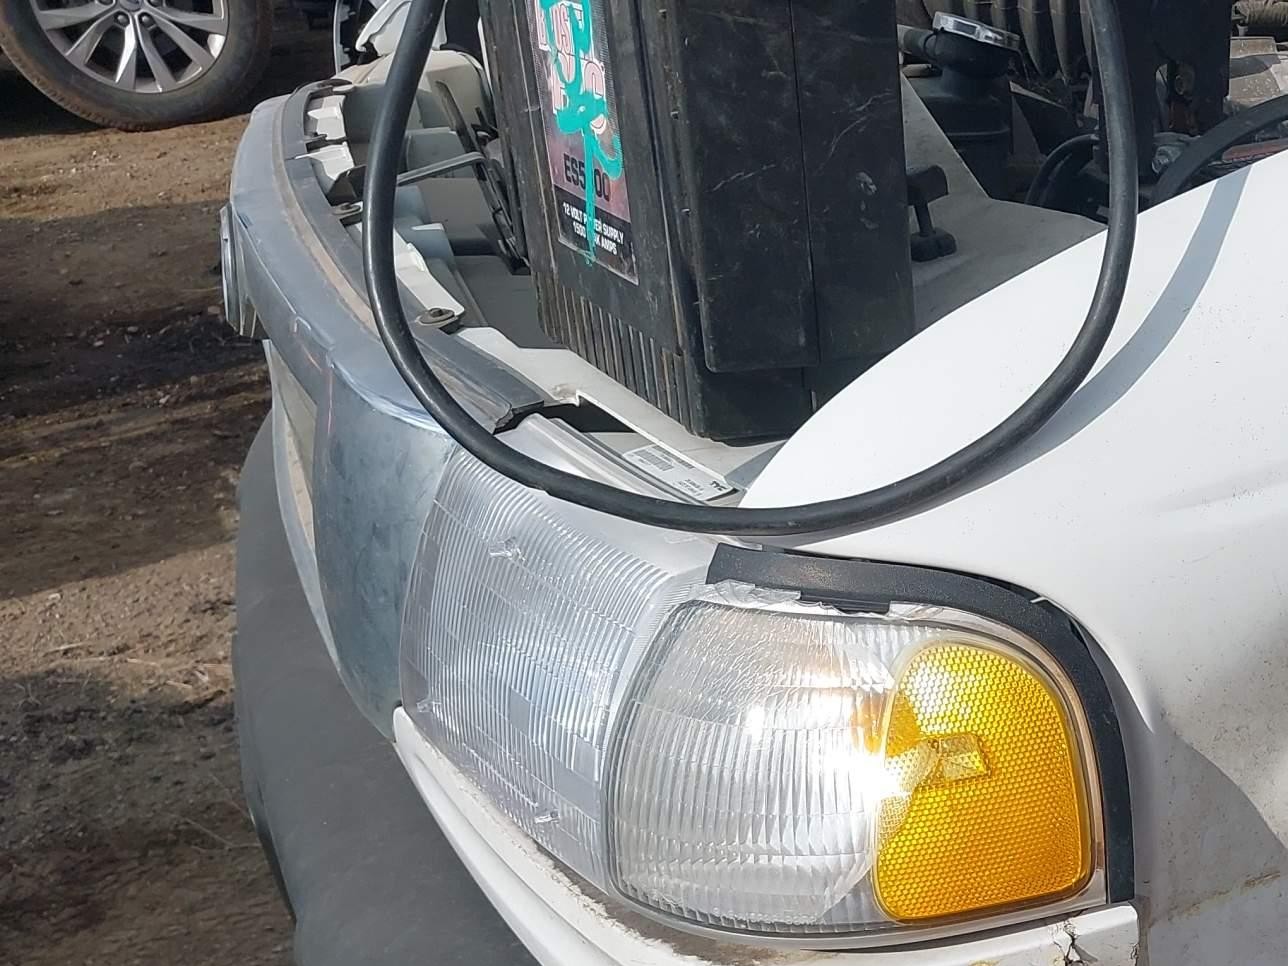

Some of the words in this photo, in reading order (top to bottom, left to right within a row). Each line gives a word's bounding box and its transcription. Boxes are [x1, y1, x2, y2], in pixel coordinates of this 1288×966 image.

[563, 152, 610, 202] ES500
[562, 201, 571, 217] 12
[570, 204, 583, 223] VOLT
[583, 211, 602, 234] PER
[603, 222, 624, 245] SUPPLY
[601, 235, 618, 255] AMPS
